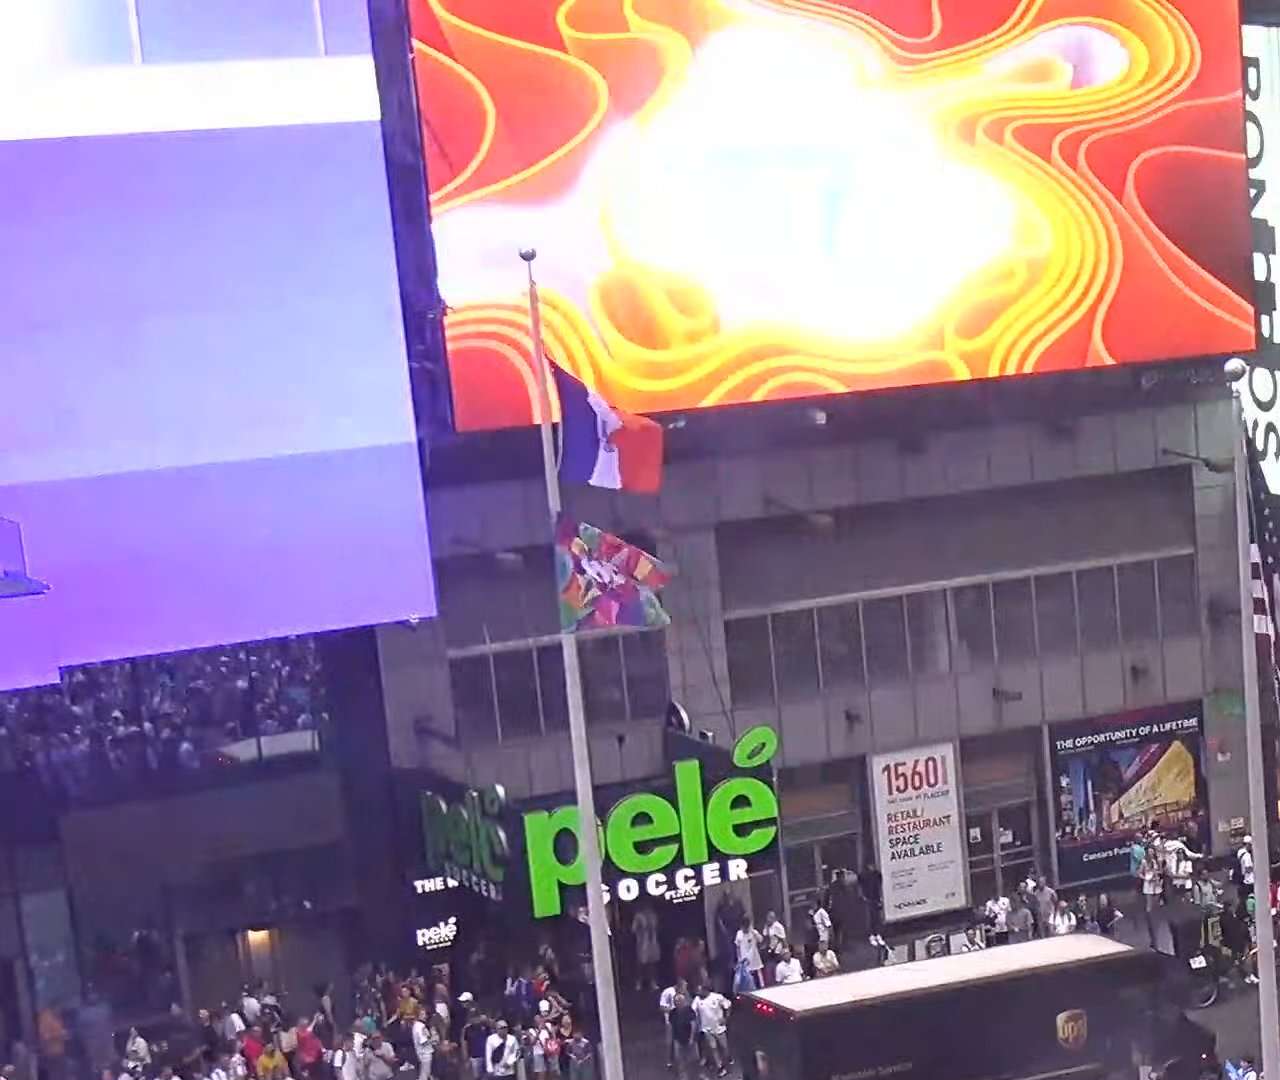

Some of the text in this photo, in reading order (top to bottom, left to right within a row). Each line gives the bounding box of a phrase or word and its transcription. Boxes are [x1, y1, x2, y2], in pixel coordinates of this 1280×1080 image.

[1055, 738, 1074, 750] THE
[1075, 727, 1138, 748] OPPORTUNITY
[1139, 725, 1150, 736] OF
[1152, 723, 1159, 732] A
[1160, 717, 1198, 732] LIFETIME
[522, 726, 778, 919] pelé
[888, 815, 952, 837] RESTAURANT
[888, 834, 920, 850] SPACE
[890, 842, 943, 862] AVAILABLE
[413, 876, 445, 894] THE
[416, 916, 457, 947] pelé
